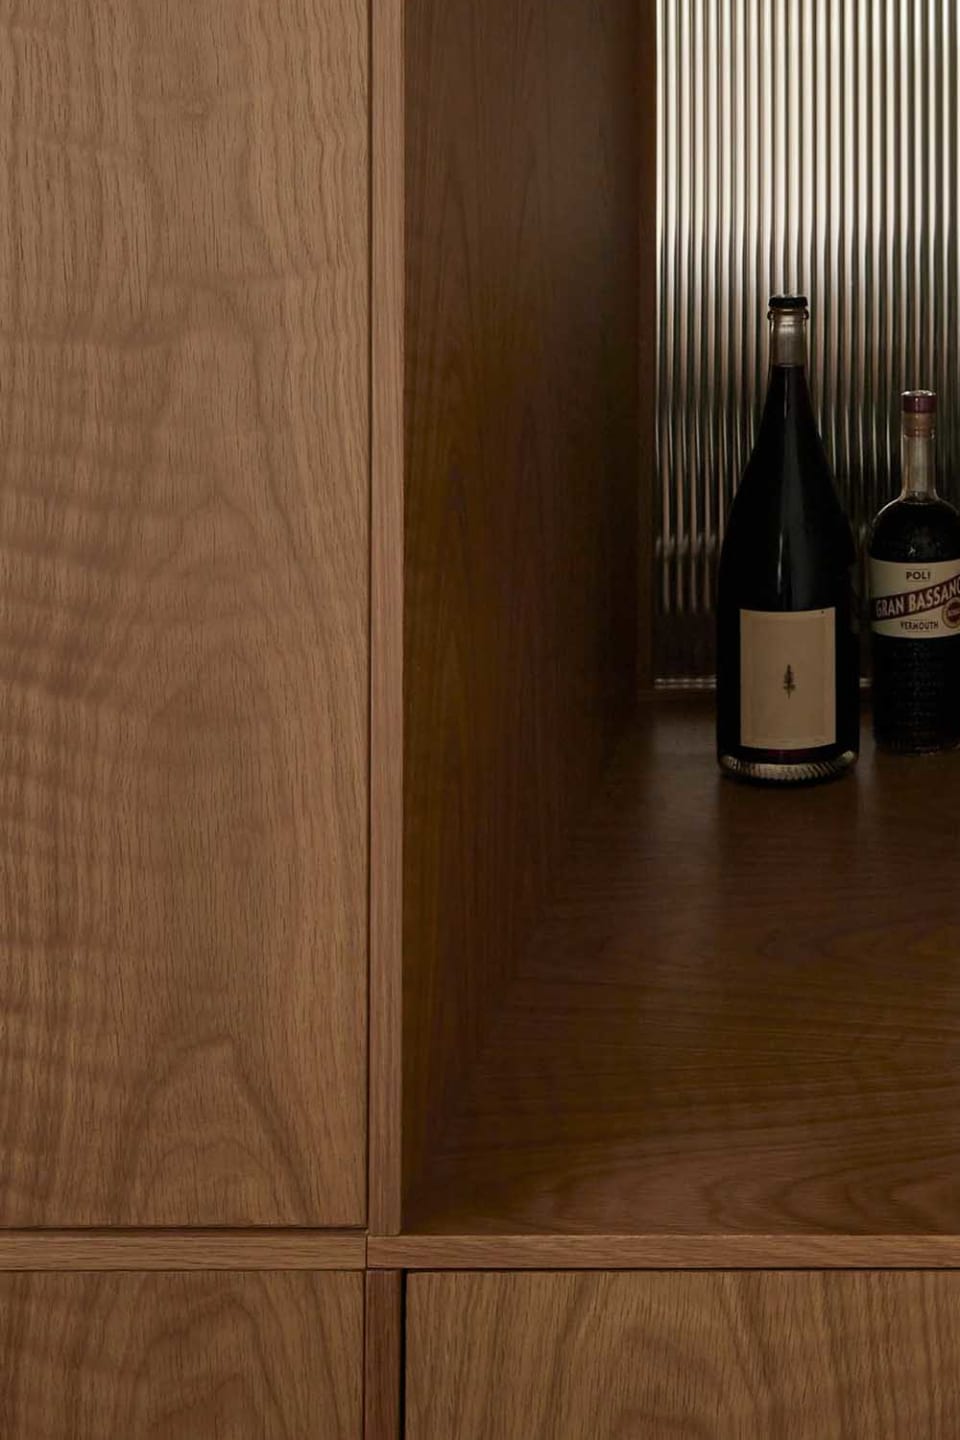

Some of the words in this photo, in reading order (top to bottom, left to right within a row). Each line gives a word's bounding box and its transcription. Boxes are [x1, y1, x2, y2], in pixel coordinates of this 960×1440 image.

[906, 571, 931, 580] POLI
[876, 597, 905, 618] GRAN
[900, 622, 938, 631] VERMOUTH
